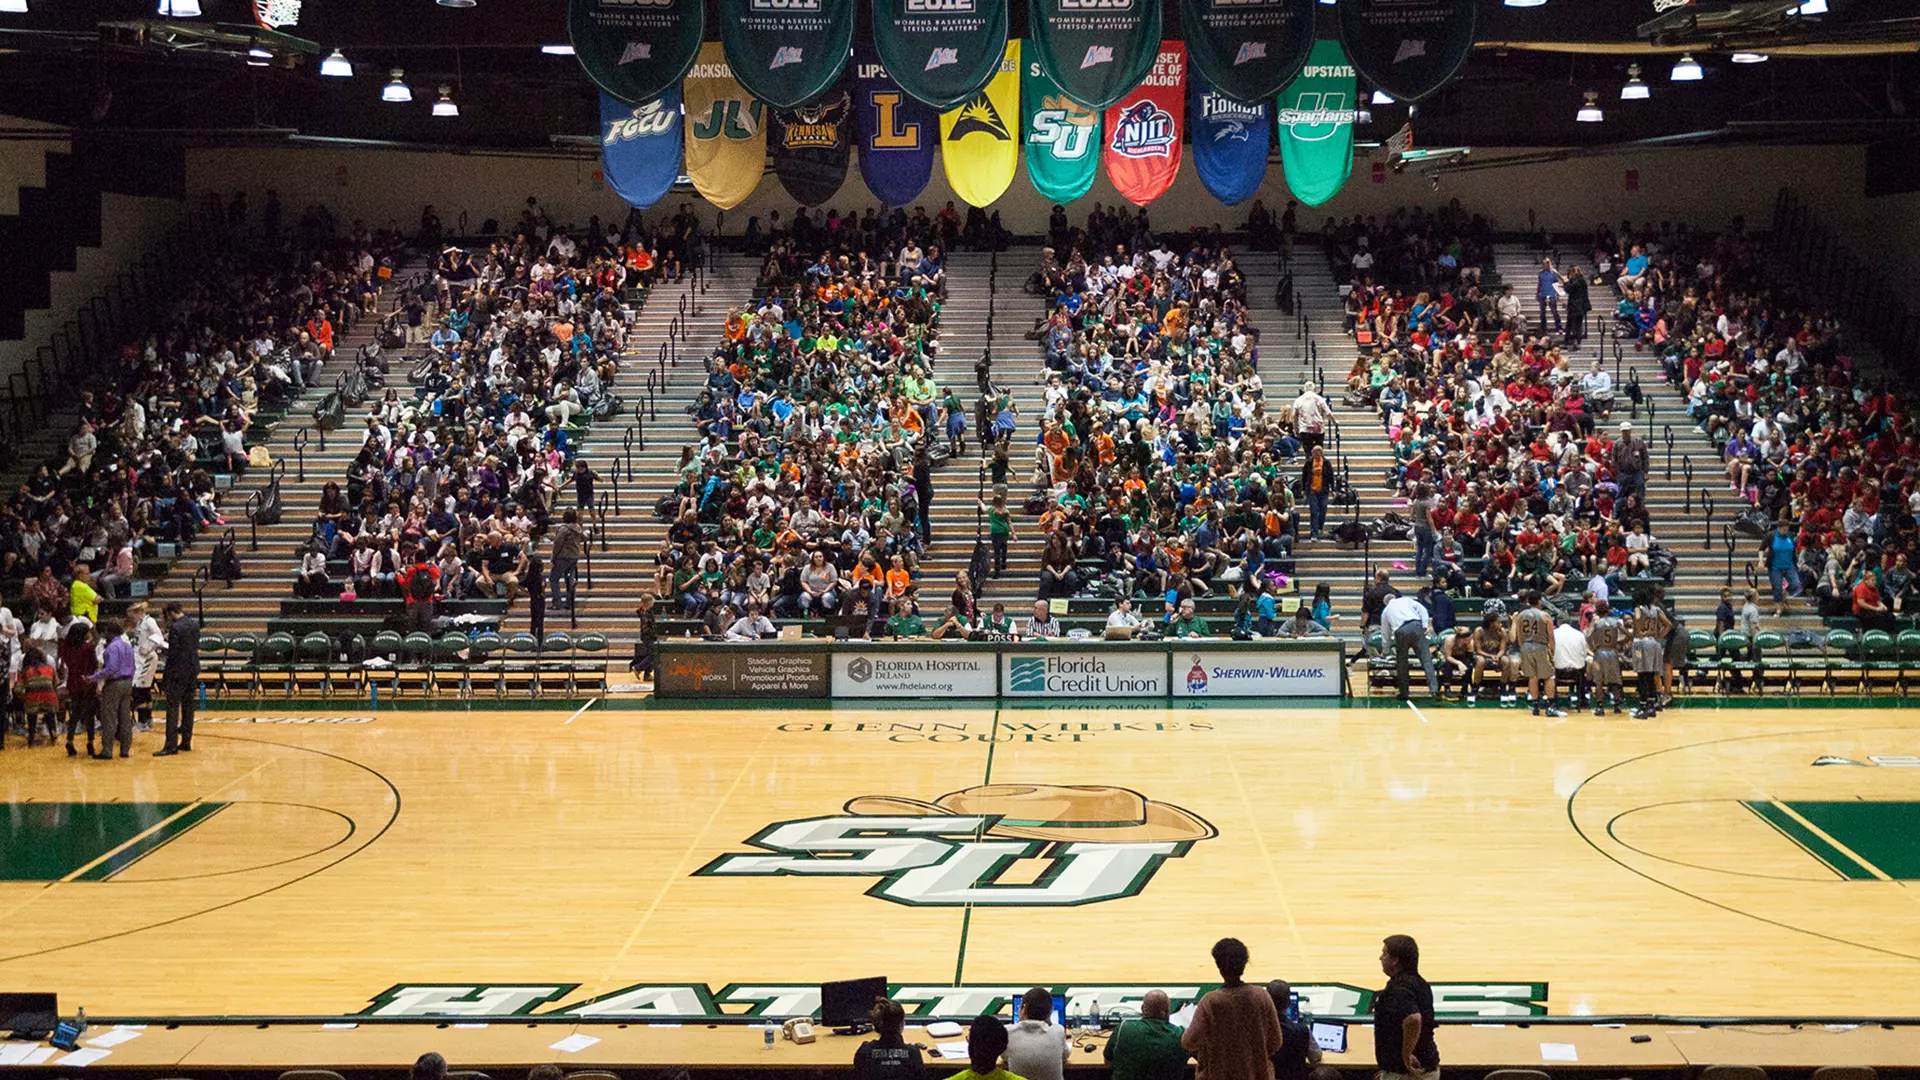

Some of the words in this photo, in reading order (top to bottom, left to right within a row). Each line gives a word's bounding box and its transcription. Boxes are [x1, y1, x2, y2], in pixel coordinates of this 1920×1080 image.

[1168, 64, 1182, 75] OF
[1304, 66, 1356, 78] UPSTATE
[693, 100, 765, 139] JU
[871, 92, 920, 149] L
[1279, 108, 1355, 126] Spartans
[603, 110, 677, 146] FGCU
[1028, 108, 1096, 160] SU
[1124, 118, 1168, 146] NJIT
[1522, 619, 1539, 634] 24
[987, 634, 1013, 642] POSS
[1604, 629, 1612, 643] 5
[747, 657, 777, 665] Stadium
[779, 657, 812, 667] Graphics
[876, 660, 922, 671] FLORIDA
[927, 660, 980, 671] HOSPITAL
[1048, 656, 1106, 673] Florida
[777, 666, 811, 675] Graphics
[1212, 666, 1323, 679] SHERWIN-WILLIAMS
[702, 674, 727, 682] WORKS
[741, 674, 785, 682] Promotional
[787, 674, 819, 682] Products
[1047, 675, 1101, 692] Credit
[1105, 675, 1156, 692] Union
[751, 682, 780, 691] Apparel
[782, 682, 788, 690] &
[790, 682, 808, 690] More
[876, 682, 953, 692] www.fhdeland.org
[776, 722, 968, 732] GLENN
[1000, 722, 1215, 732] WILKES
[888, 733, 1096, 743] COURT
[689, 813, 1197, 907] SU
